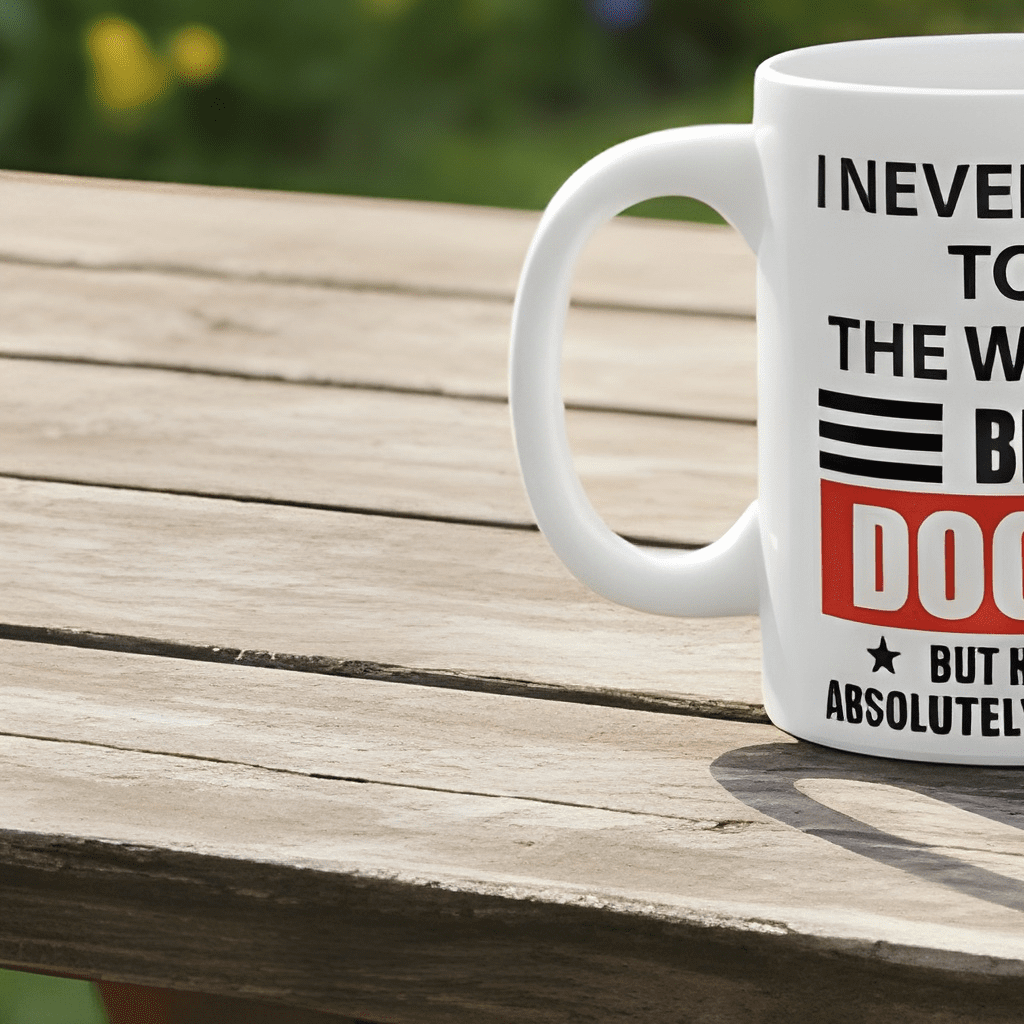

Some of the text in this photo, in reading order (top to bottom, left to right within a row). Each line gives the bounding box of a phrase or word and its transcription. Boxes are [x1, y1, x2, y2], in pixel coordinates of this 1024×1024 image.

[818, 155, 827, 208] I
[828, 315, 948, 381] THE
[930, 645, 1000, 686] BUT
